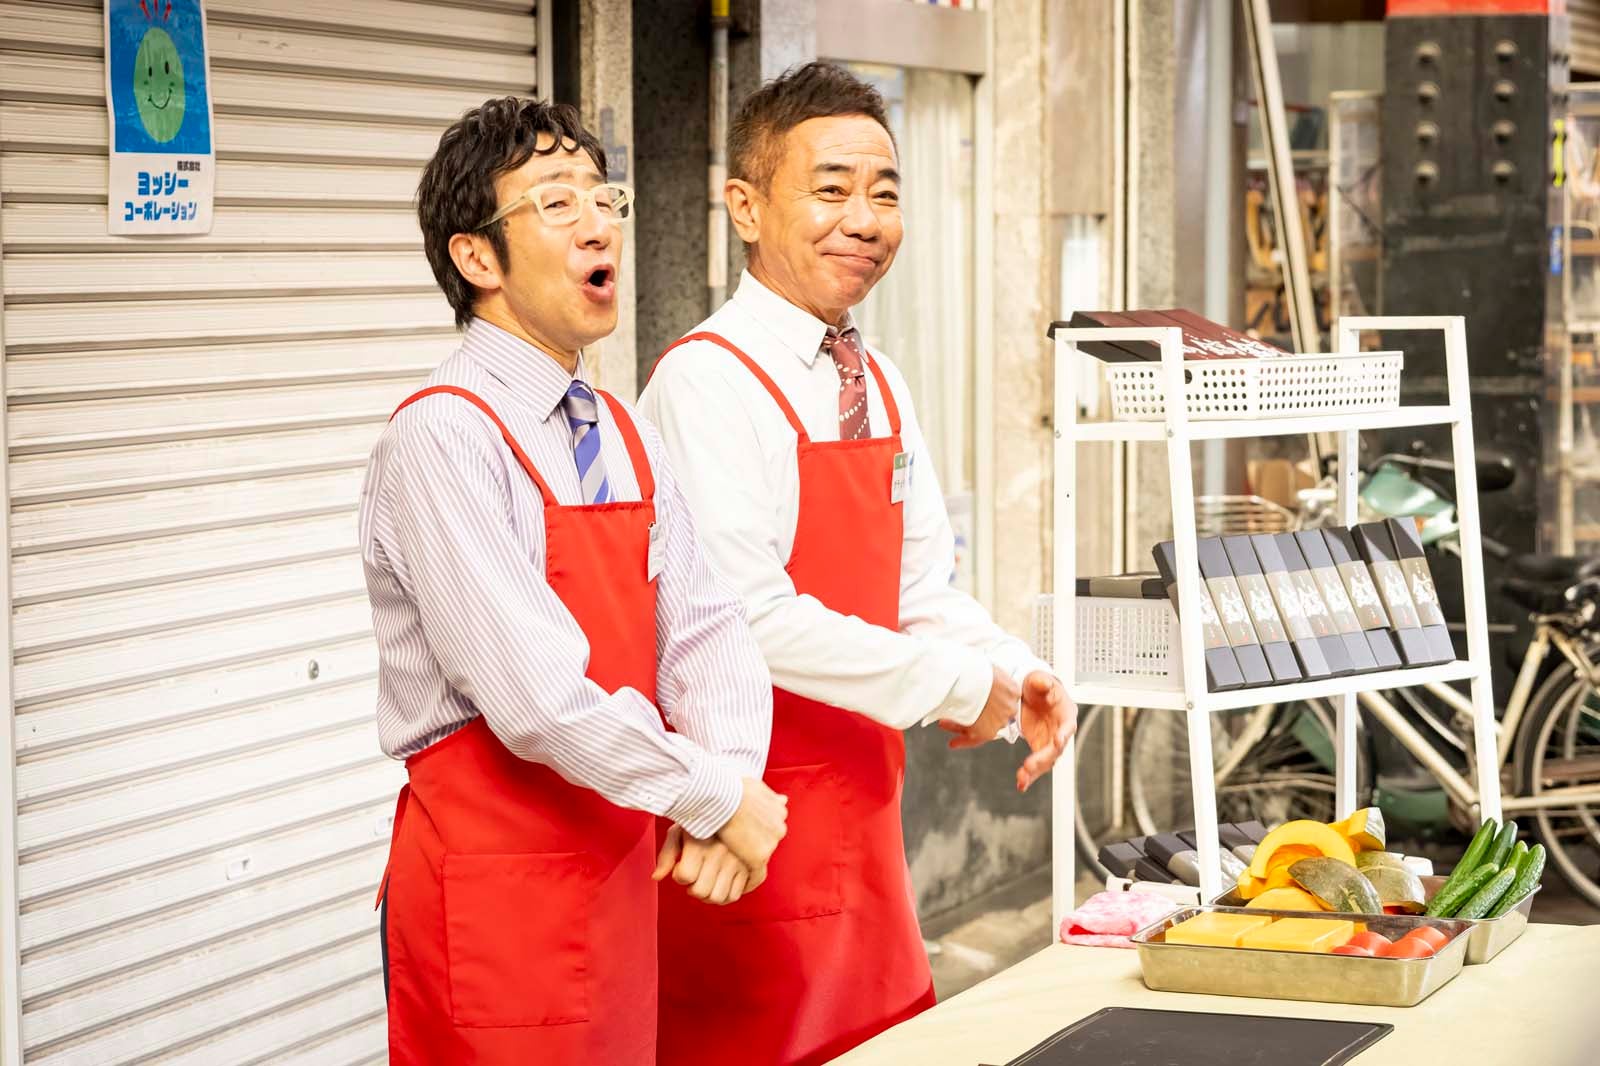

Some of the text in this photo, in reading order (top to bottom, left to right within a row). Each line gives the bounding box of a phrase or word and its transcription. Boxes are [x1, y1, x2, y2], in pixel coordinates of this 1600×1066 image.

[138, 172, 188, 195] ヨッシー
[125, 201, 197, 221] コーポレーション
